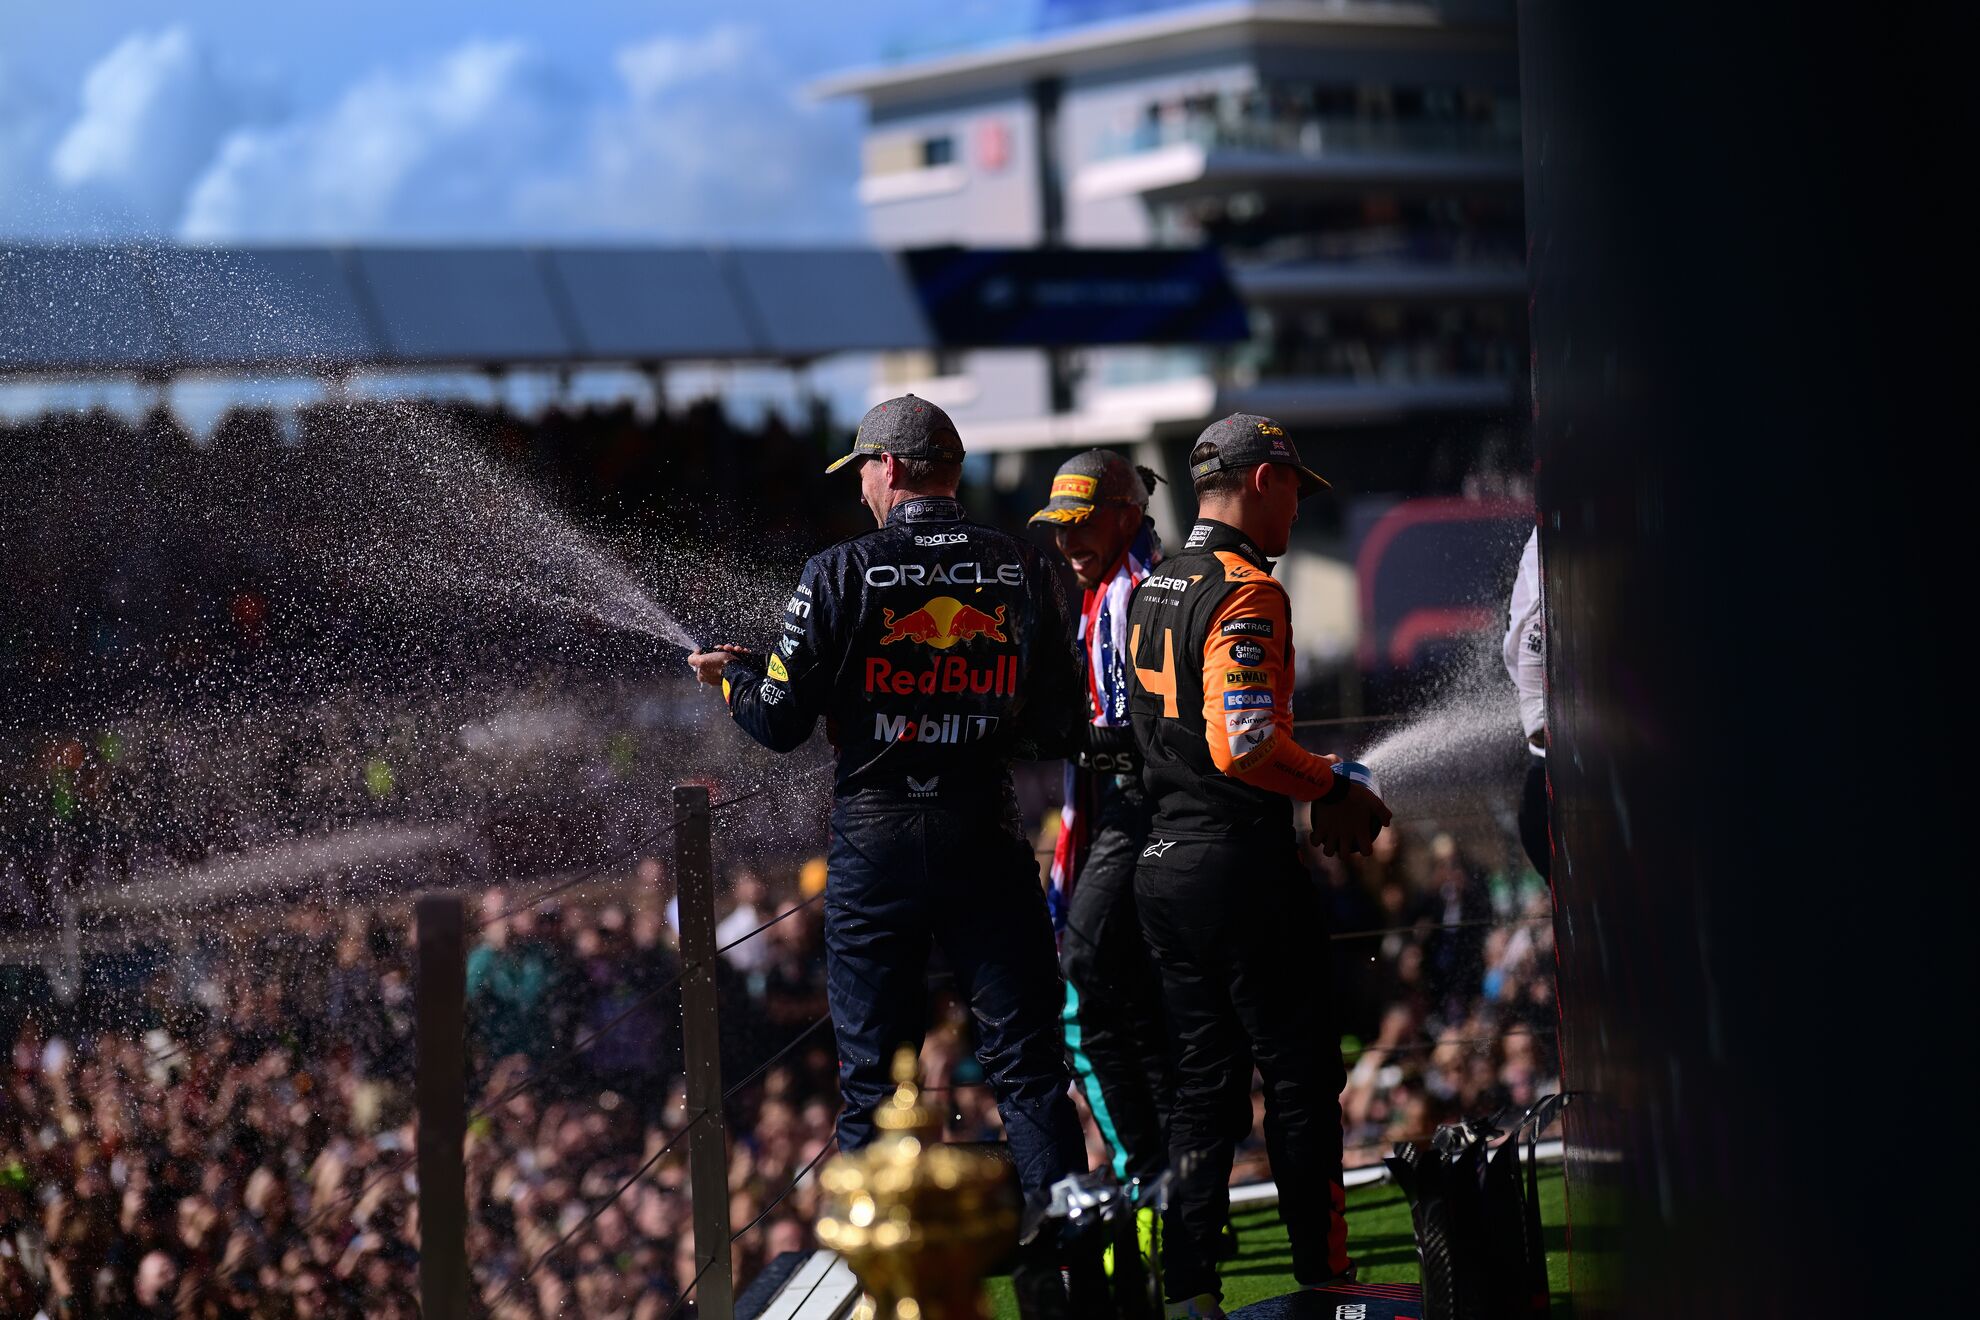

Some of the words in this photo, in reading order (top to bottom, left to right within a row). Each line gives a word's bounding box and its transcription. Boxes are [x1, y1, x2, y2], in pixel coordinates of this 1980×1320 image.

[914, 533, 968, 547] sparco
[865, 562, 1021, 588] ORACLE
[1223, 622, 1271, 633] DARKTRACE
[1130, 624, 1180, 719] 4
[1227, 694, 1273, 706] ECOLAB
[873, 712, 961, 744] Mobil
